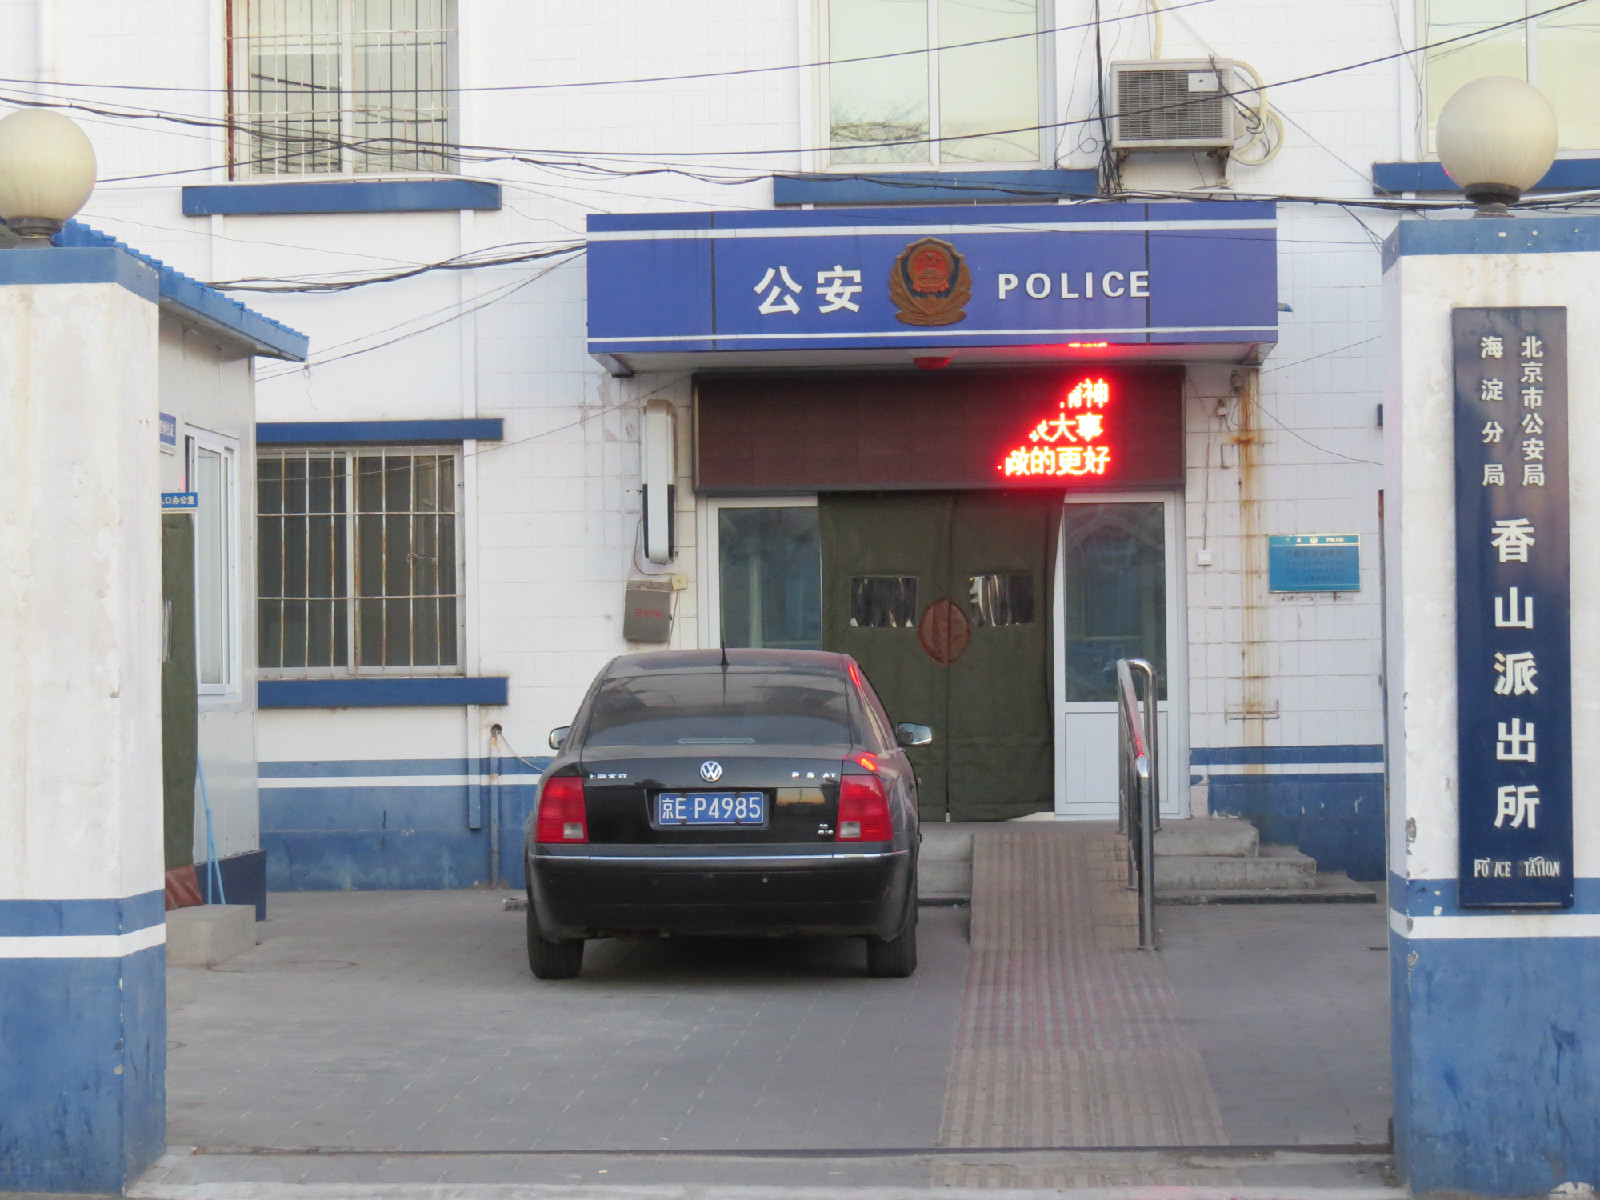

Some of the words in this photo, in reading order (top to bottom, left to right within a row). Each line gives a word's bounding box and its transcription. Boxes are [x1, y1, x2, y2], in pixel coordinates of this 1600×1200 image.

[753, 265, 863, 315] 公安
[998, 271, 1150, 300] POLICE
[1480, 336, 1505, 487] 海淀分局
[1520, 336, 1545, 487] 北京市公安局
[1491, 518, 1540, 829] 香山派出所
